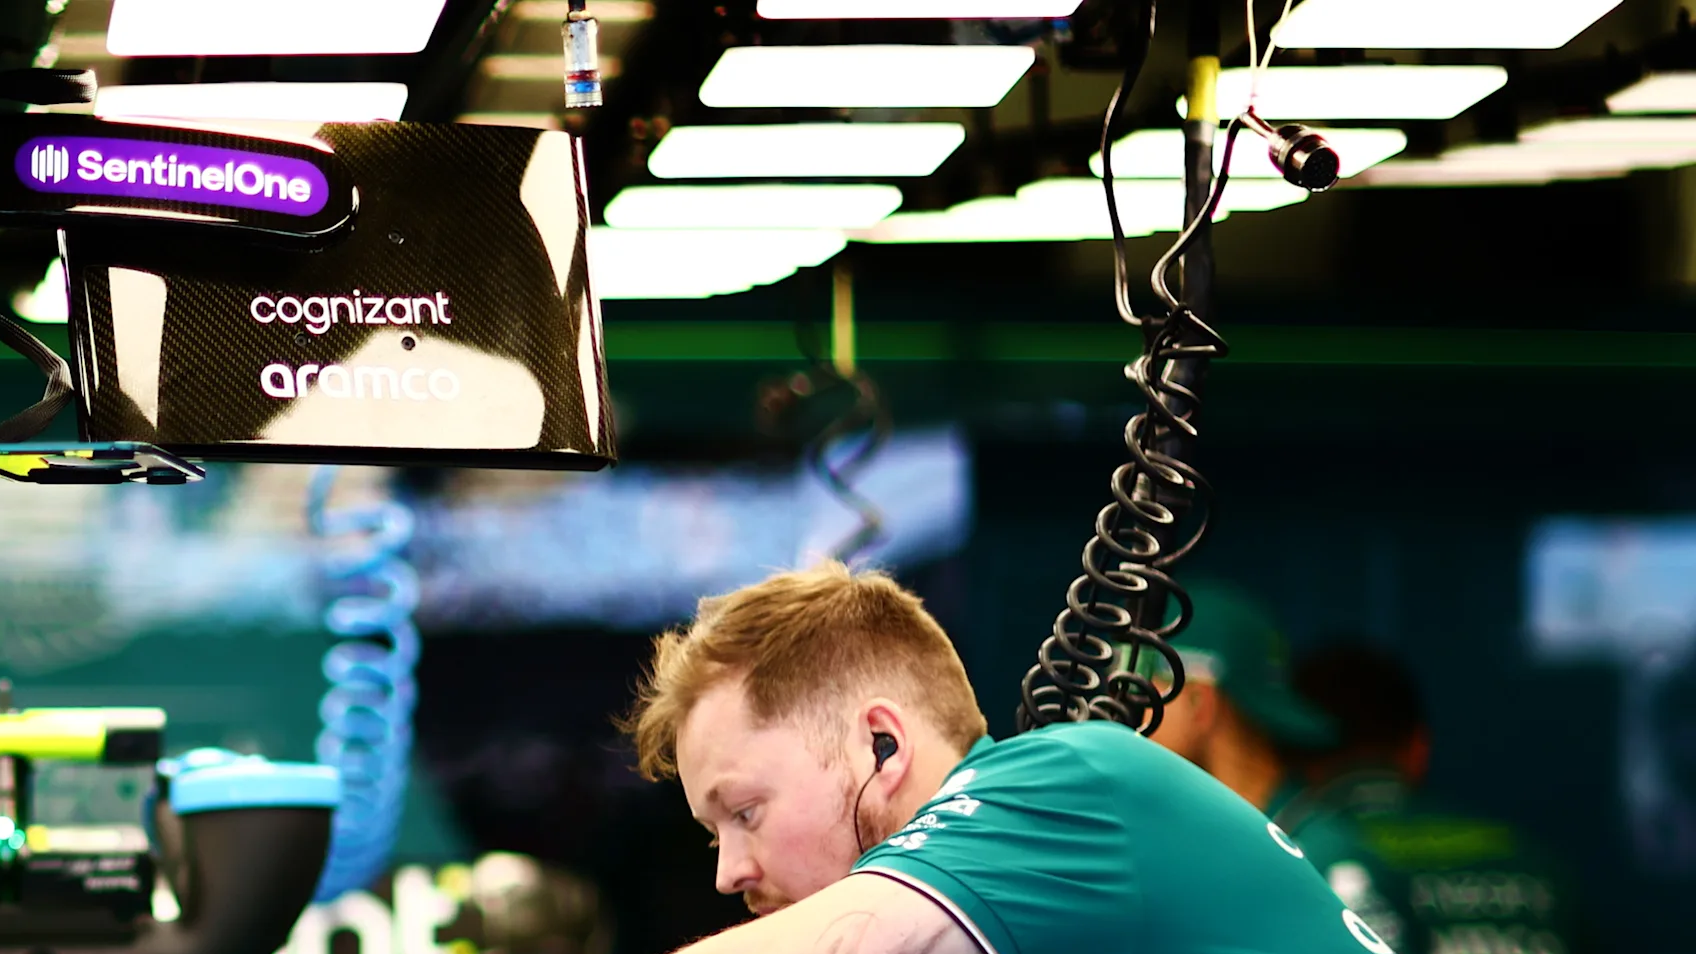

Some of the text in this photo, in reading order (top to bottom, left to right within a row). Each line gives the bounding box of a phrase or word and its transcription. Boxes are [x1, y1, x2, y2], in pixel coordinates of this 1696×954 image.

[76, 149, 312, 203] SentinelOne
[250, 288, 452, 335] cognizant
[260, 363, 461, 400] aramco
